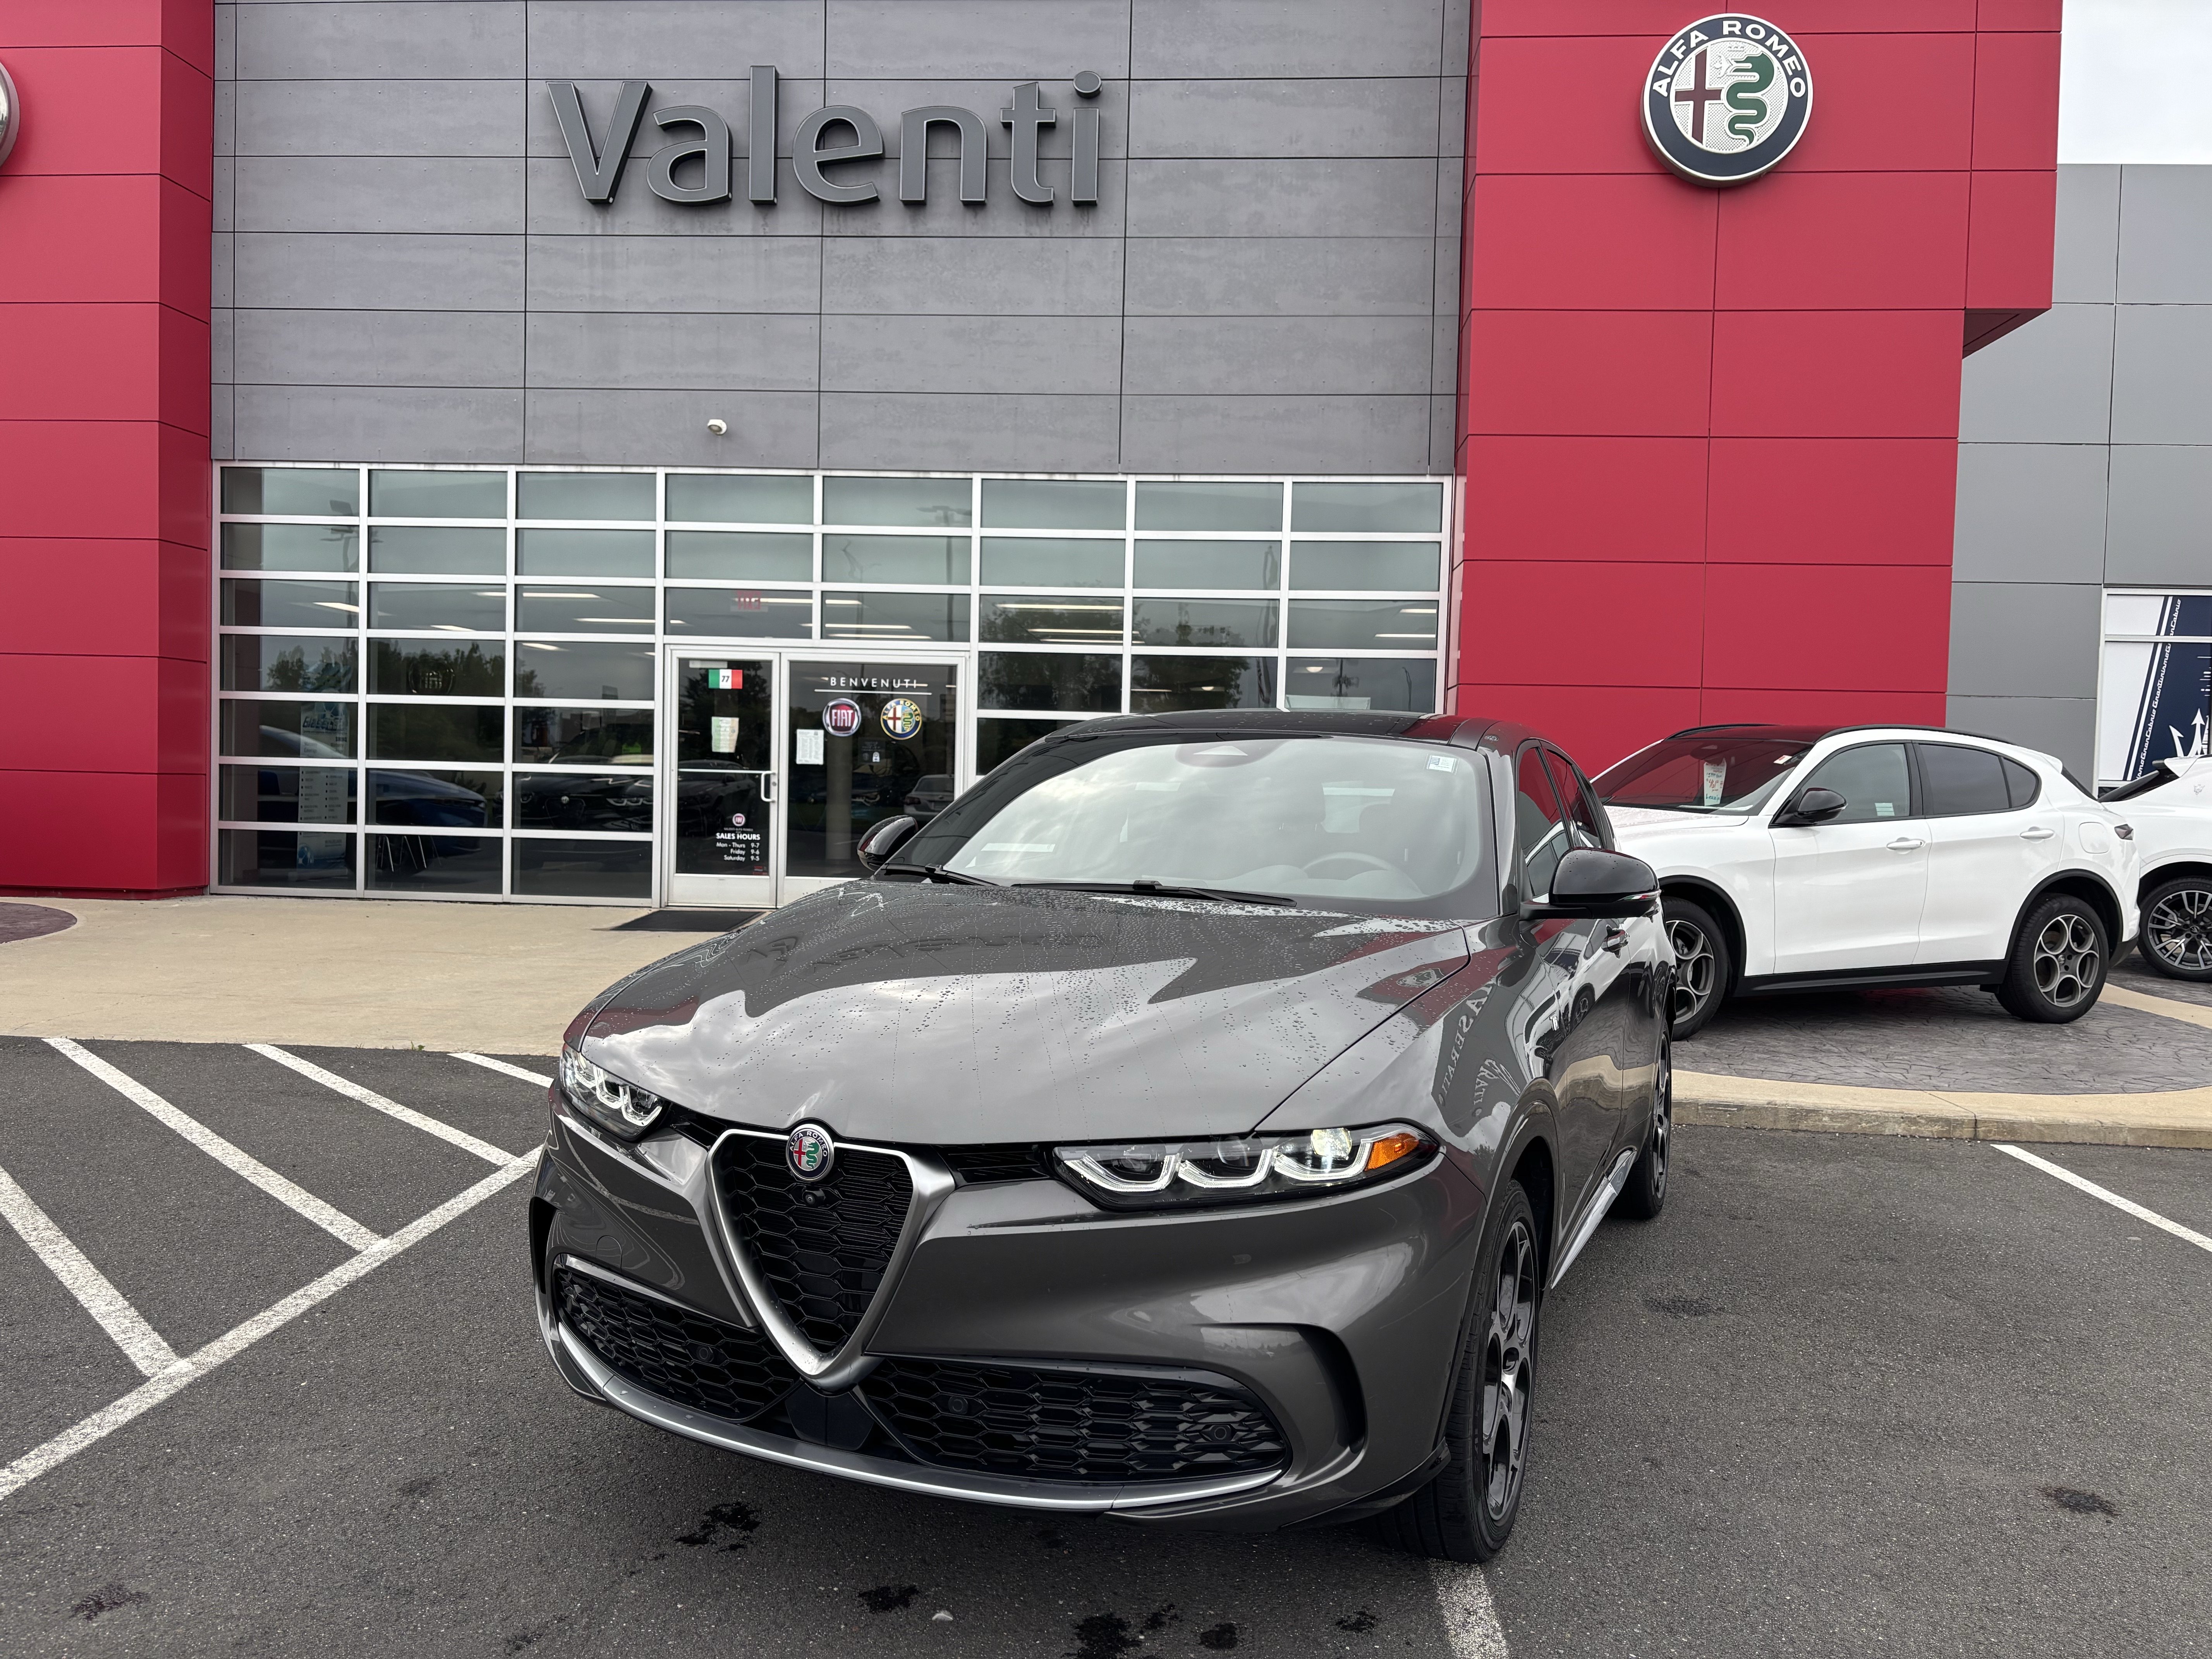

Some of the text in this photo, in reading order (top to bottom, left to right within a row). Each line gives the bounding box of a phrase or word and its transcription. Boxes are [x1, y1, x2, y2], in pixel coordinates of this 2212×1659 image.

[1652, 21, 1806, 97] ALFA ROMEO
[546, 65, 1103, 207] Valenti
[830, 677, 917, 689] BENVENUTI
[832, 709, 854, 727] FIAT
[883, 700, 920, 721] ALFA ROMEO
[790, 1131, 828, 1157] ALFA ROMEO
